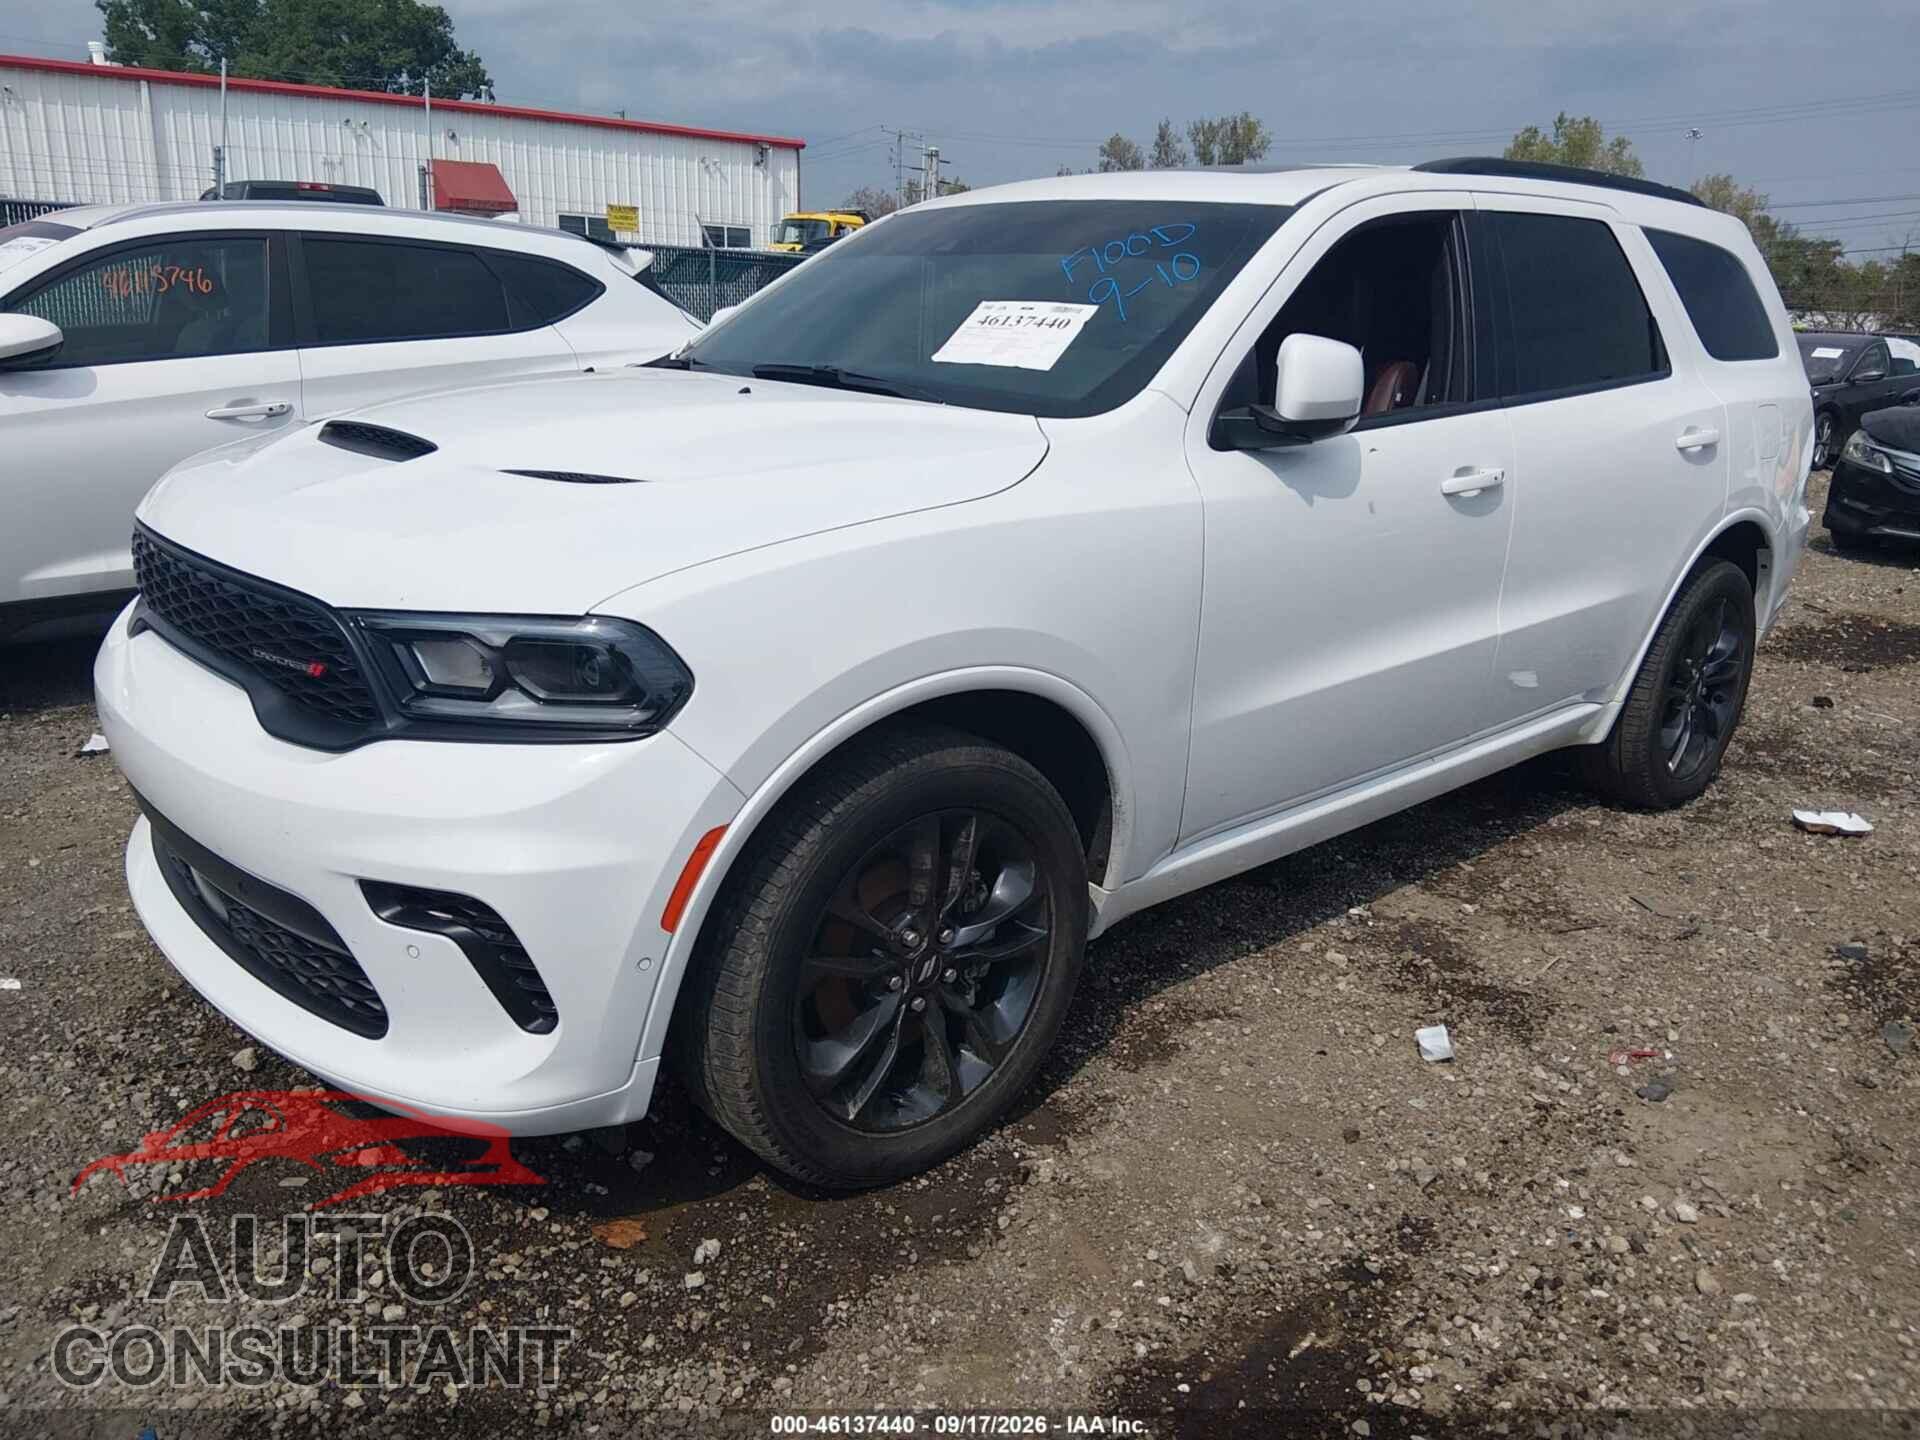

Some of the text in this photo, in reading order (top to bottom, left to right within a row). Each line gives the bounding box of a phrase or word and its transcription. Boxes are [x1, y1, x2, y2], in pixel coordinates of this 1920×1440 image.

[1089, 253, 1200, 321] 9-10
[977, 315, 1071, 329] 46137440
[249, 646, 308, 671] DODGE
